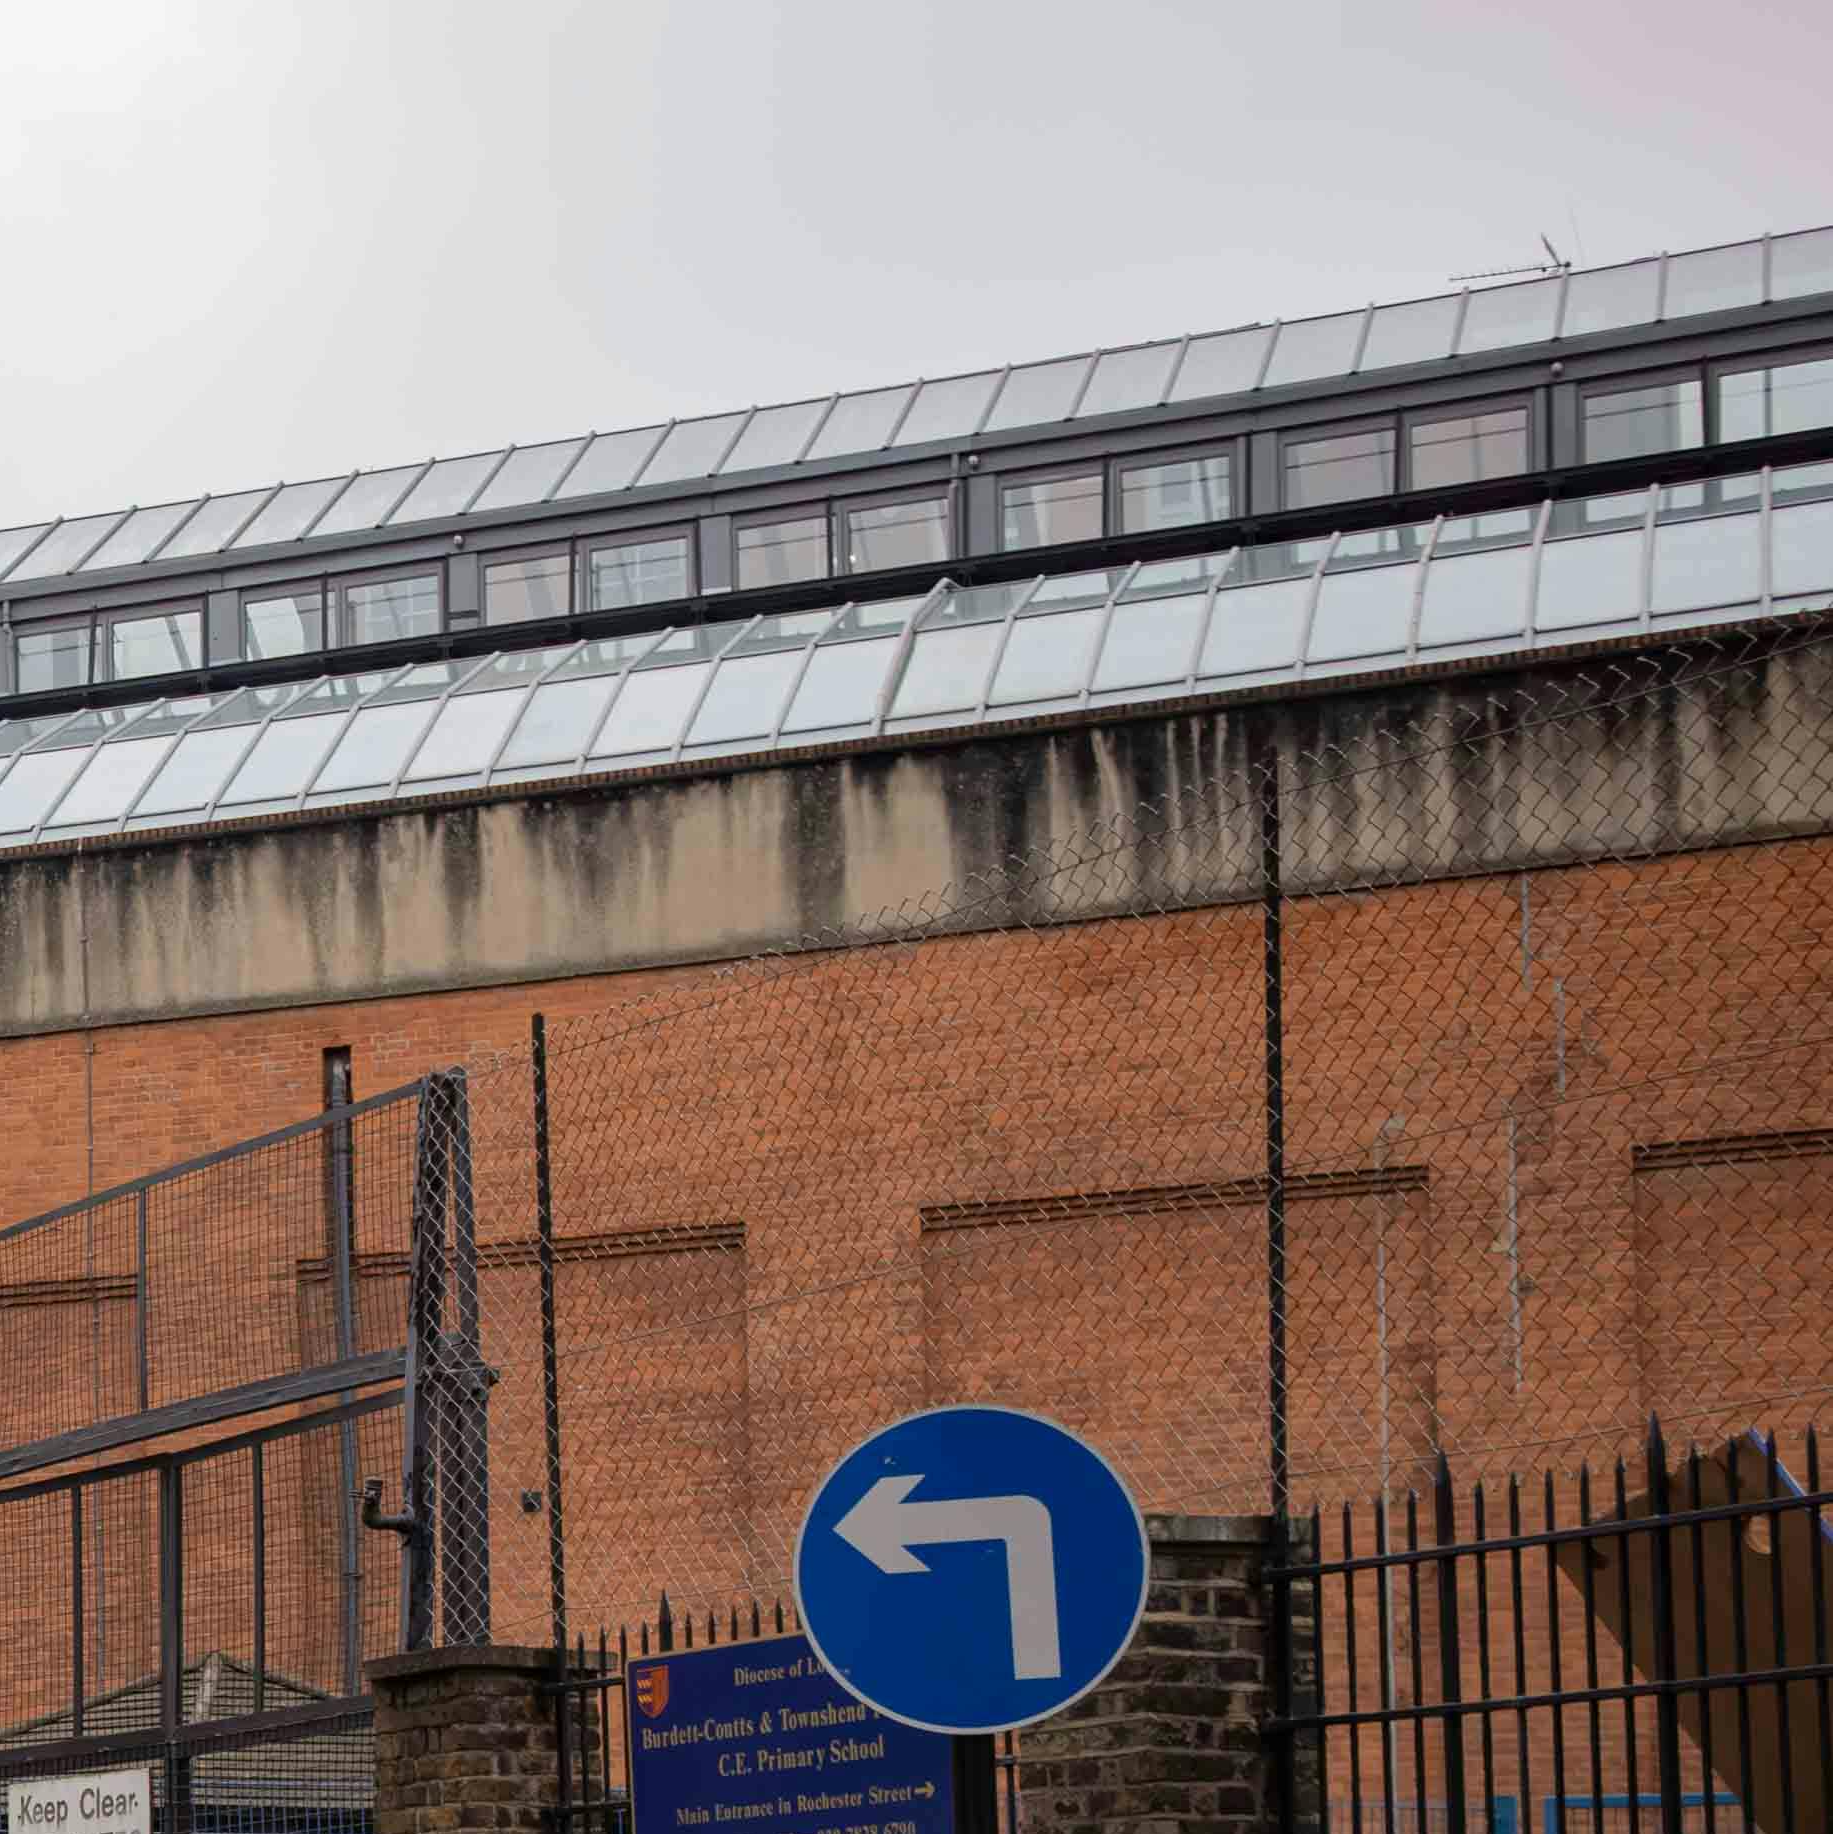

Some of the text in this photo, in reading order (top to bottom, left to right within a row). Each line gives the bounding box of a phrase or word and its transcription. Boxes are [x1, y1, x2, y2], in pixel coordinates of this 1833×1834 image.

[734, 1666, 784, 1687] Diocese
[789, 1657, 804, 1678] of
[642, 1716, 754, 1750] Burdett-Coutts
[759, 1711, 773, 1735] &
[778, 1700, 867, 1732] Townshend
[718, 1733, 885, 1777] C.E. Primary School
[20, 1786, 136, 1829] Keep Clear
[676, 1785, 912, 1825] Main Entrance in Rochester Street
